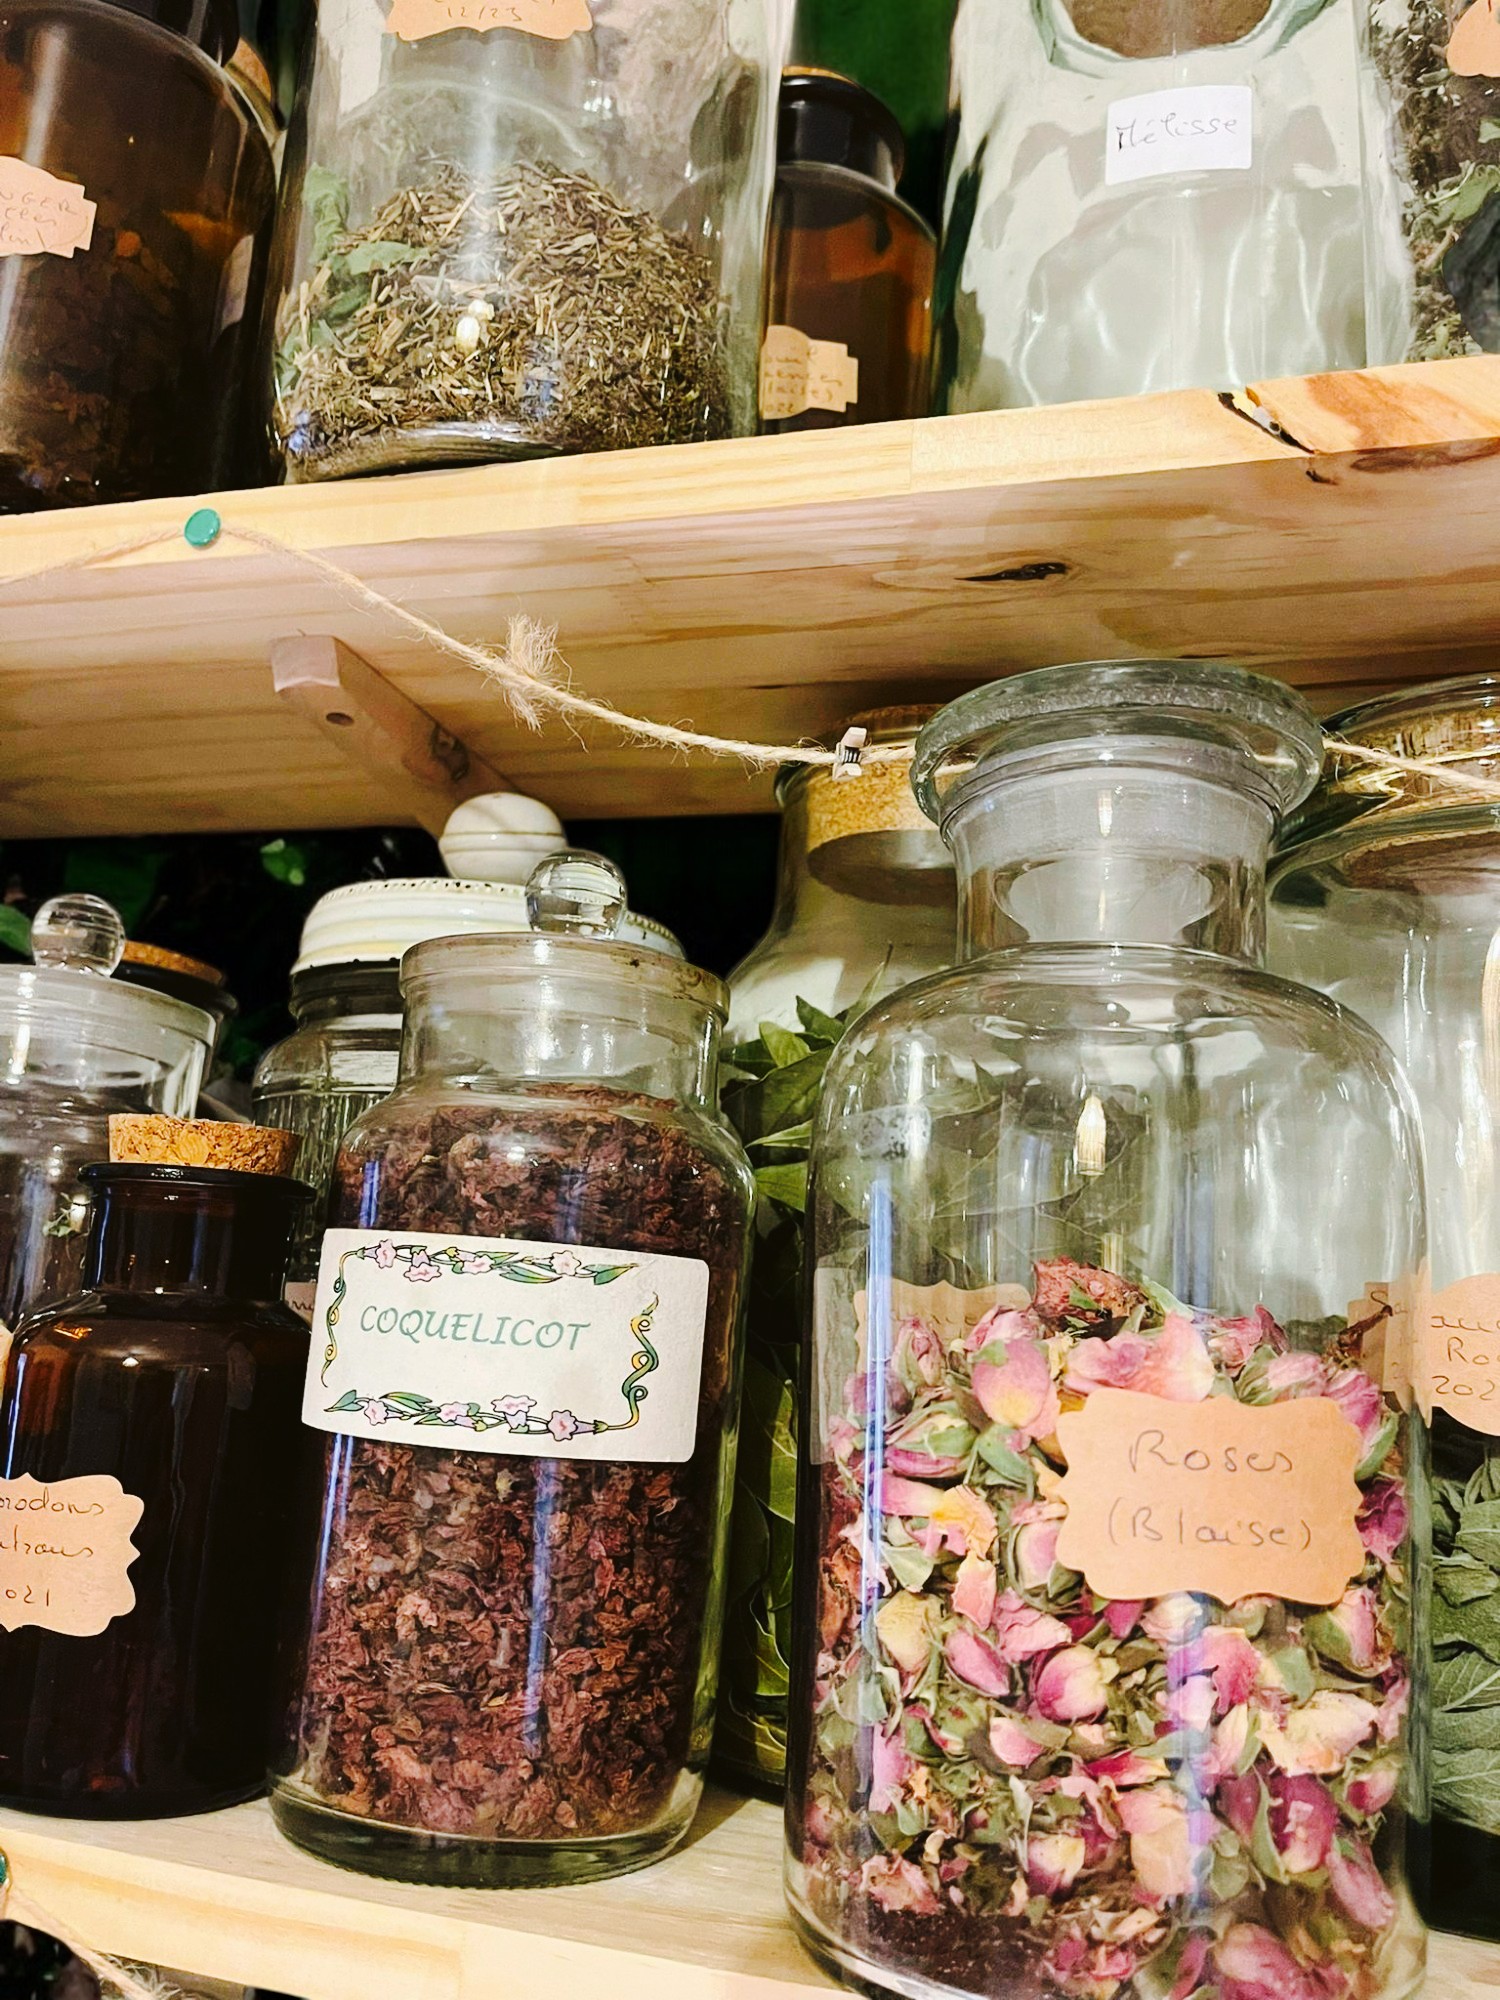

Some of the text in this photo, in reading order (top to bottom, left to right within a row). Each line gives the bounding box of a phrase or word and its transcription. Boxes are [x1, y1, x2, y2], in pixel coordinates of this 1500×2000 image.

[446, 7, 523, 22] 12/23
[360, 1305, 592, 1350] COQUELICOT
[1446, 1336, 1500, 1365] Ro
[1431, 1375, 1495, 1401] 202
[1129, 1430, 1293, 1473] Roses
[1108, 1496, 1312, 1550] (Blaise)
[5, 1584, 51, 1607] 021
